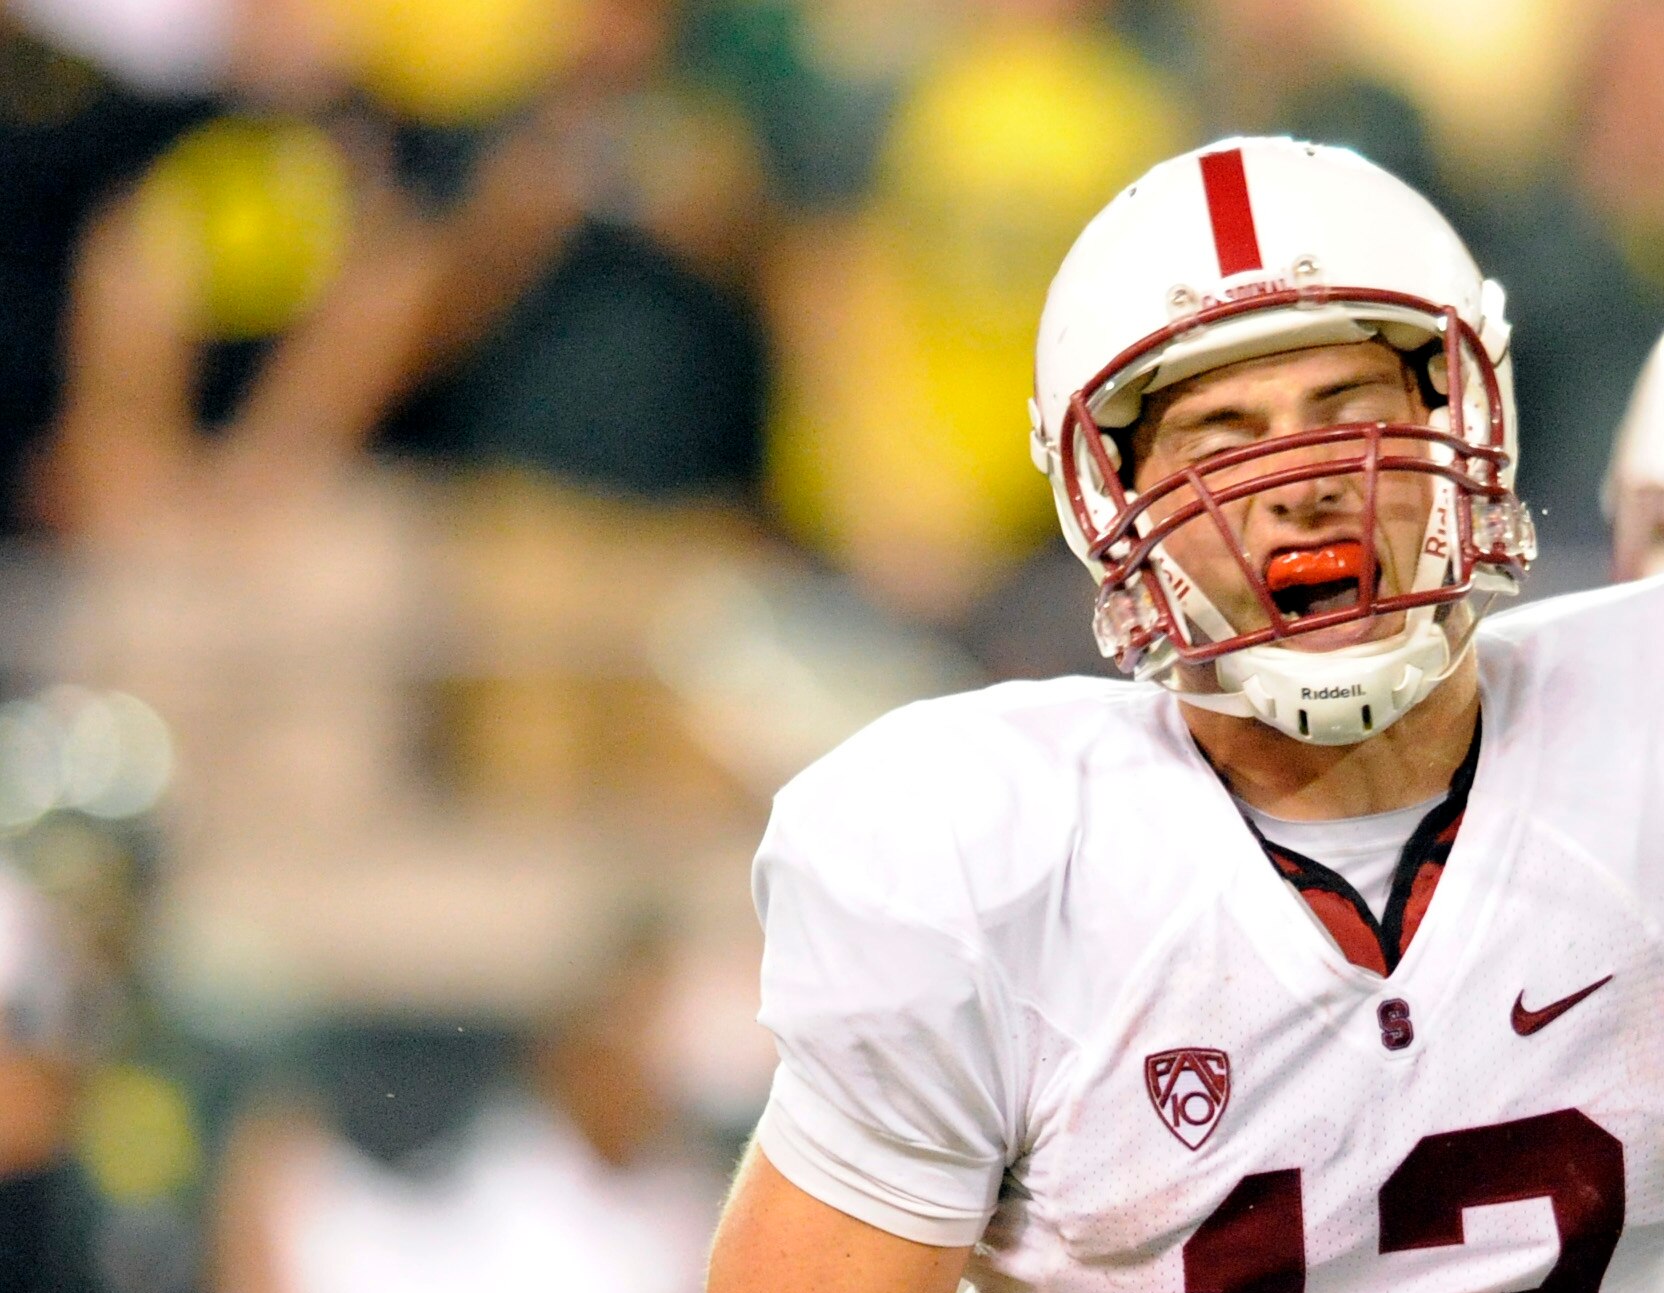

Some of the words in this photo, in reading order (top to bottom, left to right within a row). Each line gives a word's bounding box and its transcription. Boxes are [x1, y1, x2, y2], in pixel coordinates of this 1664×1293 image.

[1301, 684, 1362, 700] Riddell
[1377, 997, 1414, 1051] S
[1148, 1050, 1228, 1110] PAC
[1171, 1092, 1216, 1128] 10
